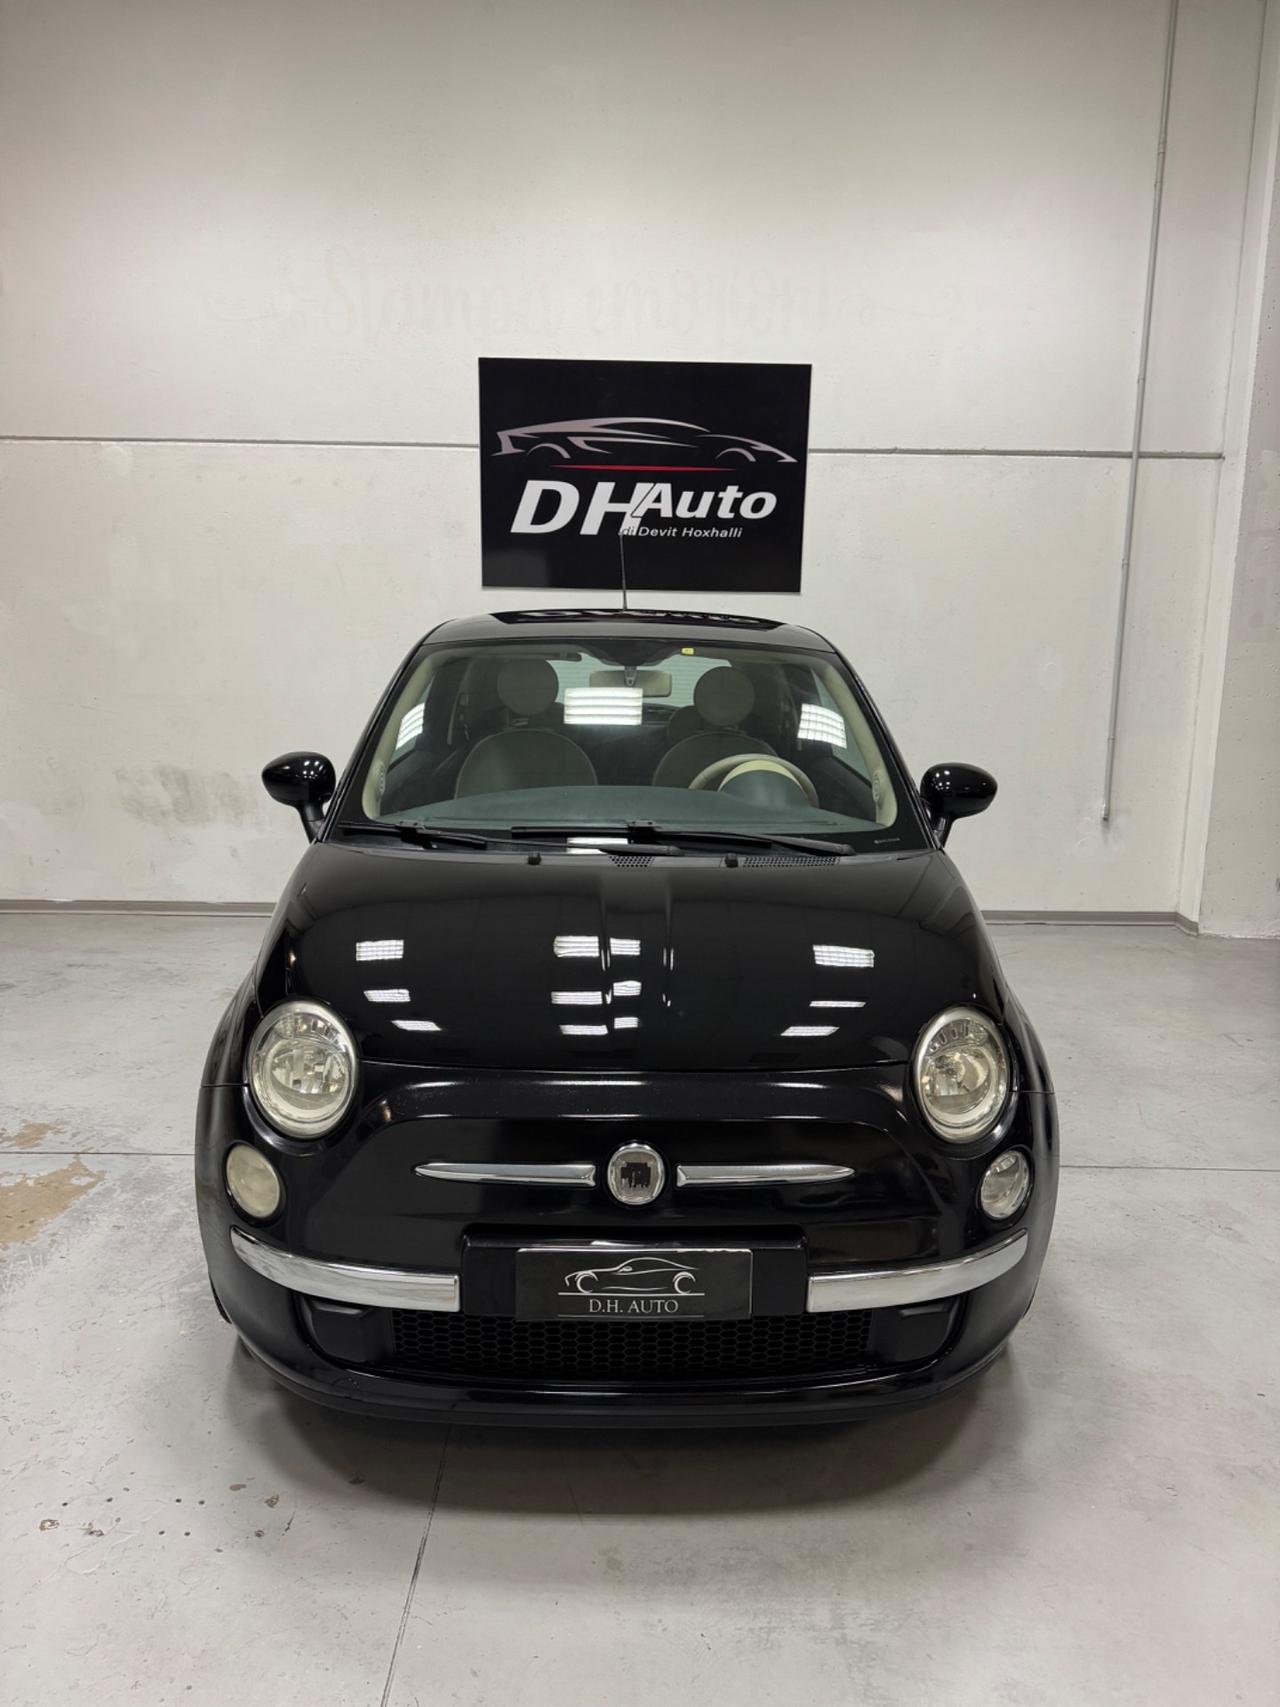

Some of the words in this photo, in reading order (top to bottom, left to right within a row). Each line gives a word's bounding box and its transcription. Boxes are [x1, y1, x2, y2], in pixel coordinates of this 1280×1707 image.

[638, 526, 678, 537] Devit
[682, 527, 743, 538] Hoxhalli
[588, 1299, 623, 1313] D.H.
[627, 1299, 679, 1313] AUTO
